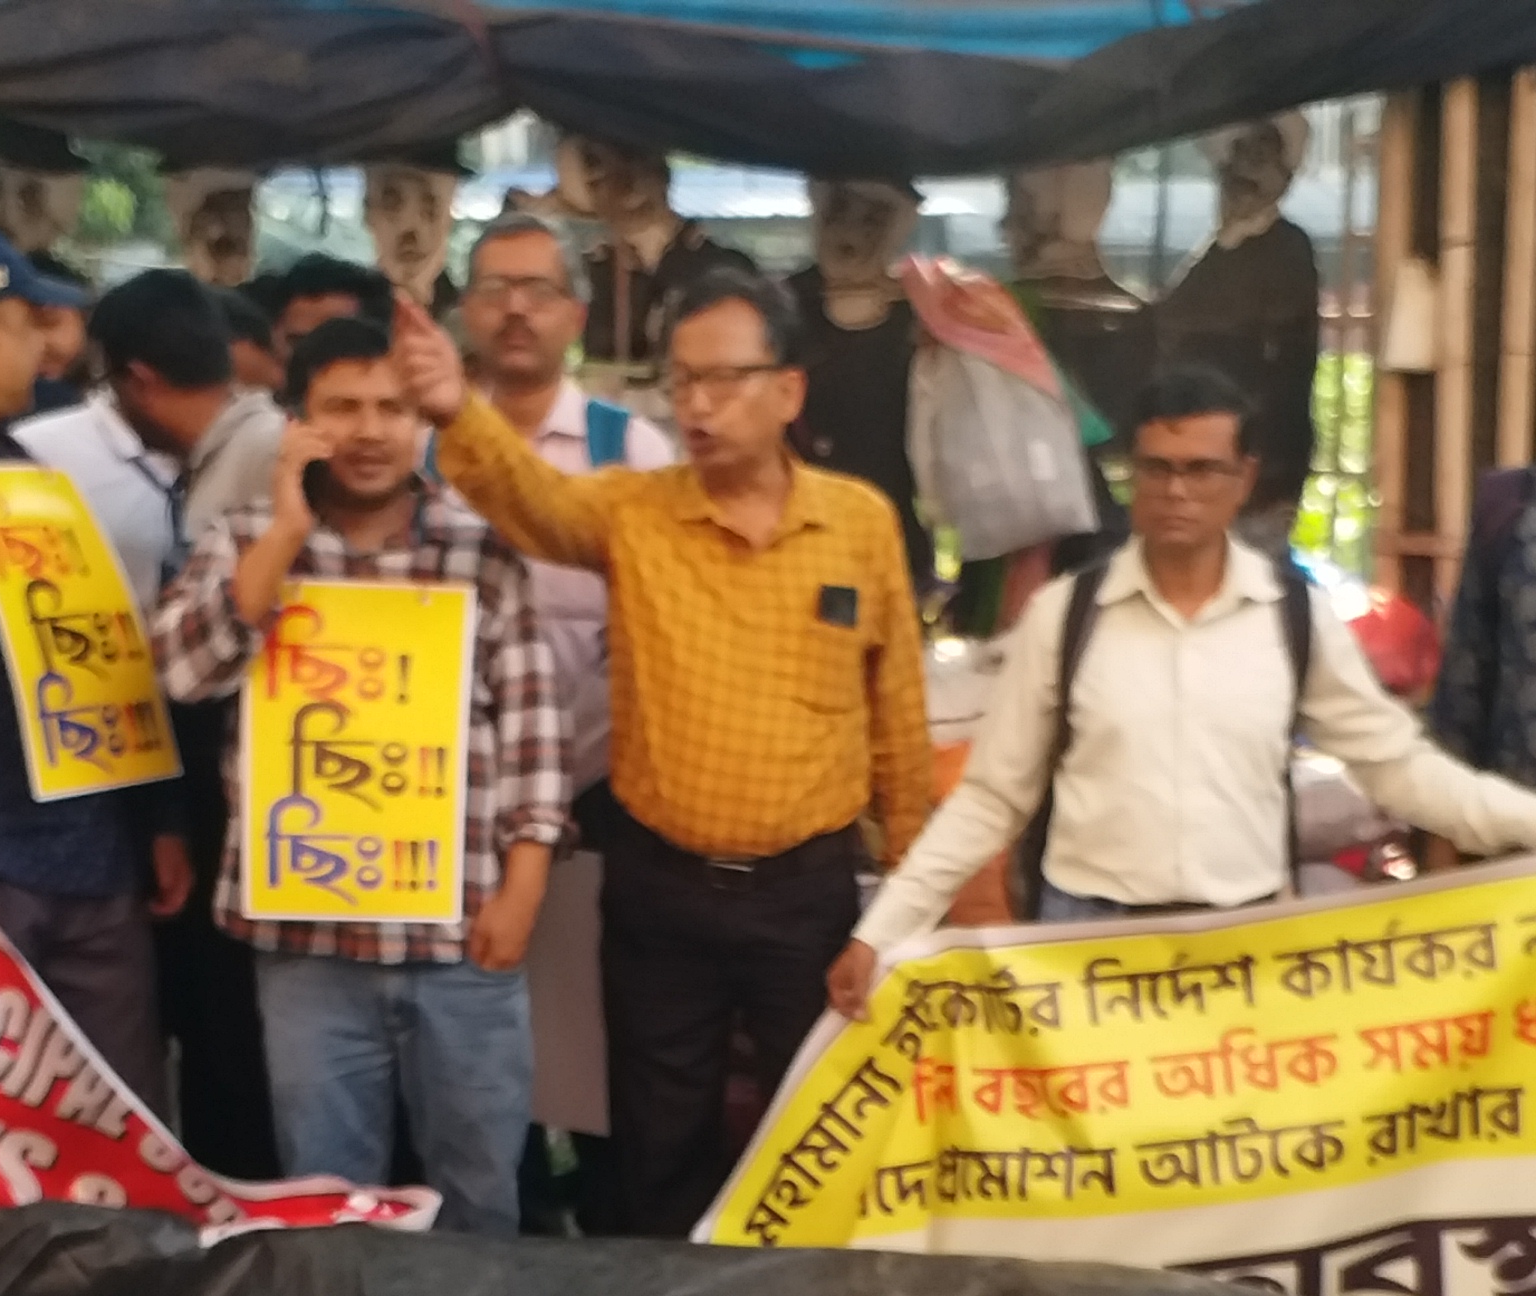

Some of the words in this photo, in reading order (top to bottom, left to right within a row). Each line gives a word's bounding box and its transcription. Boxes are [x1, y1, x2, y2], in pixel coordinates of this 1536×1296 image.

[1080, 953, 1257, 1027] নির্দেশ
[1272, 918, 1498, 1000] কার্যকর
[1150, 1025, 1340, 1100] অধিক
[1359, 1009, 1496, 1073] সময়
[1133, 1116, 1345, 1188] আটকে
[1364, 1086, 1525, 1168] রাখার
